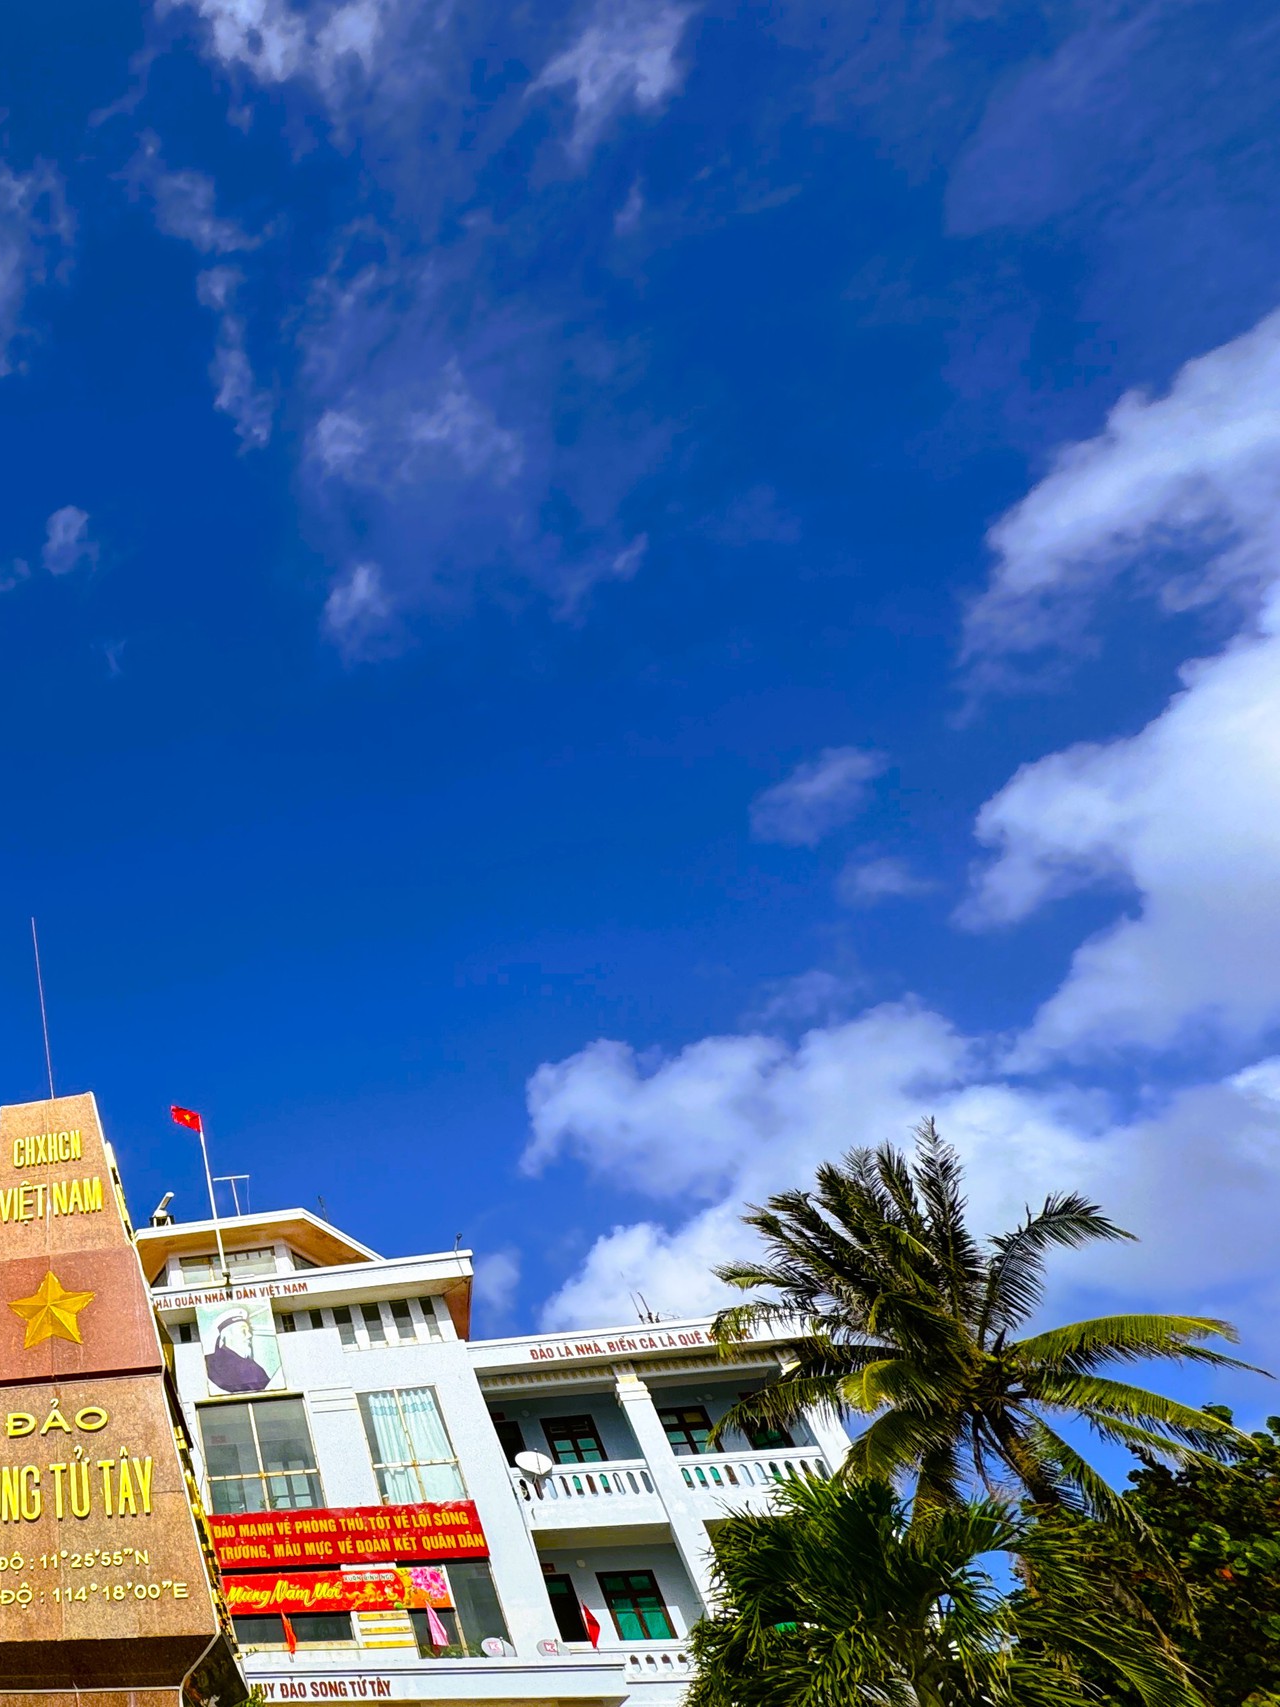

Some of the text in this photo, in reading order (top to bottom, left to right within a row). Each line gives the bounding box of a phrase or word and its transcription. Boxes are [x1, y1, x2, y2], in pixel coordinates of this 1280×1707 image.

[13, 1129, 82, 1167] CHXHCN
[52, 1176, 104, 1217] NAM
[174, 1293, 202, 1307] QUÂN
[236, 1286, 257, 1300] DÂN
[259, 1284, 281, 1298] VIỆT
[283, 1282, 309, 1295] NAM
[529, 1344, 555, 1360] ĐẢO
[556, 1342, 574, 1357] LÀ
[575, 1340, 606, 1356] NHÀ,
[606, 1335, 637, 1353] BIỂN
[639, 1333, 658, 1349] CẢ
[658, 1333, 677, 1348] LÀ
[678, 1331, 704, 1346] QUÊ
[5, 1398, 109, 1437] ĐẢO
[49, 1445, 92, 1519] TỬ
[97, 1446, 153, 1516] TÂY
[213, 1520, 236, 1538] ĐẢO
[239, 1522, 275, 1541] MẠNH
[276, 1516, 292, 1535] VỀ
[294, 1516, 337, 1535] PHÒNG
[339, 1512, 368, 1532] THỦ,
[368, 1510, 391, 1531] TỐT
[393, 1509, 410, 1529] VỀ
[411, 1508, 433, 1529] LỐI
[218, 1530, 485, 1560] TRƯỜNG, MẪU MỰC VỀ ĐOÀN KẾT QUÂN DÂN
[0, 1582, 33, 1609] ĐỘ
[270, 1579, 316, 1607] Năm
[280, 1676, 307, 1699] ĐẢO
[310, 1681, 347, 1699] SONG
[349, 1675, 368, 1697] TỬ
[368, 1676, 392, 1697] TÂY
